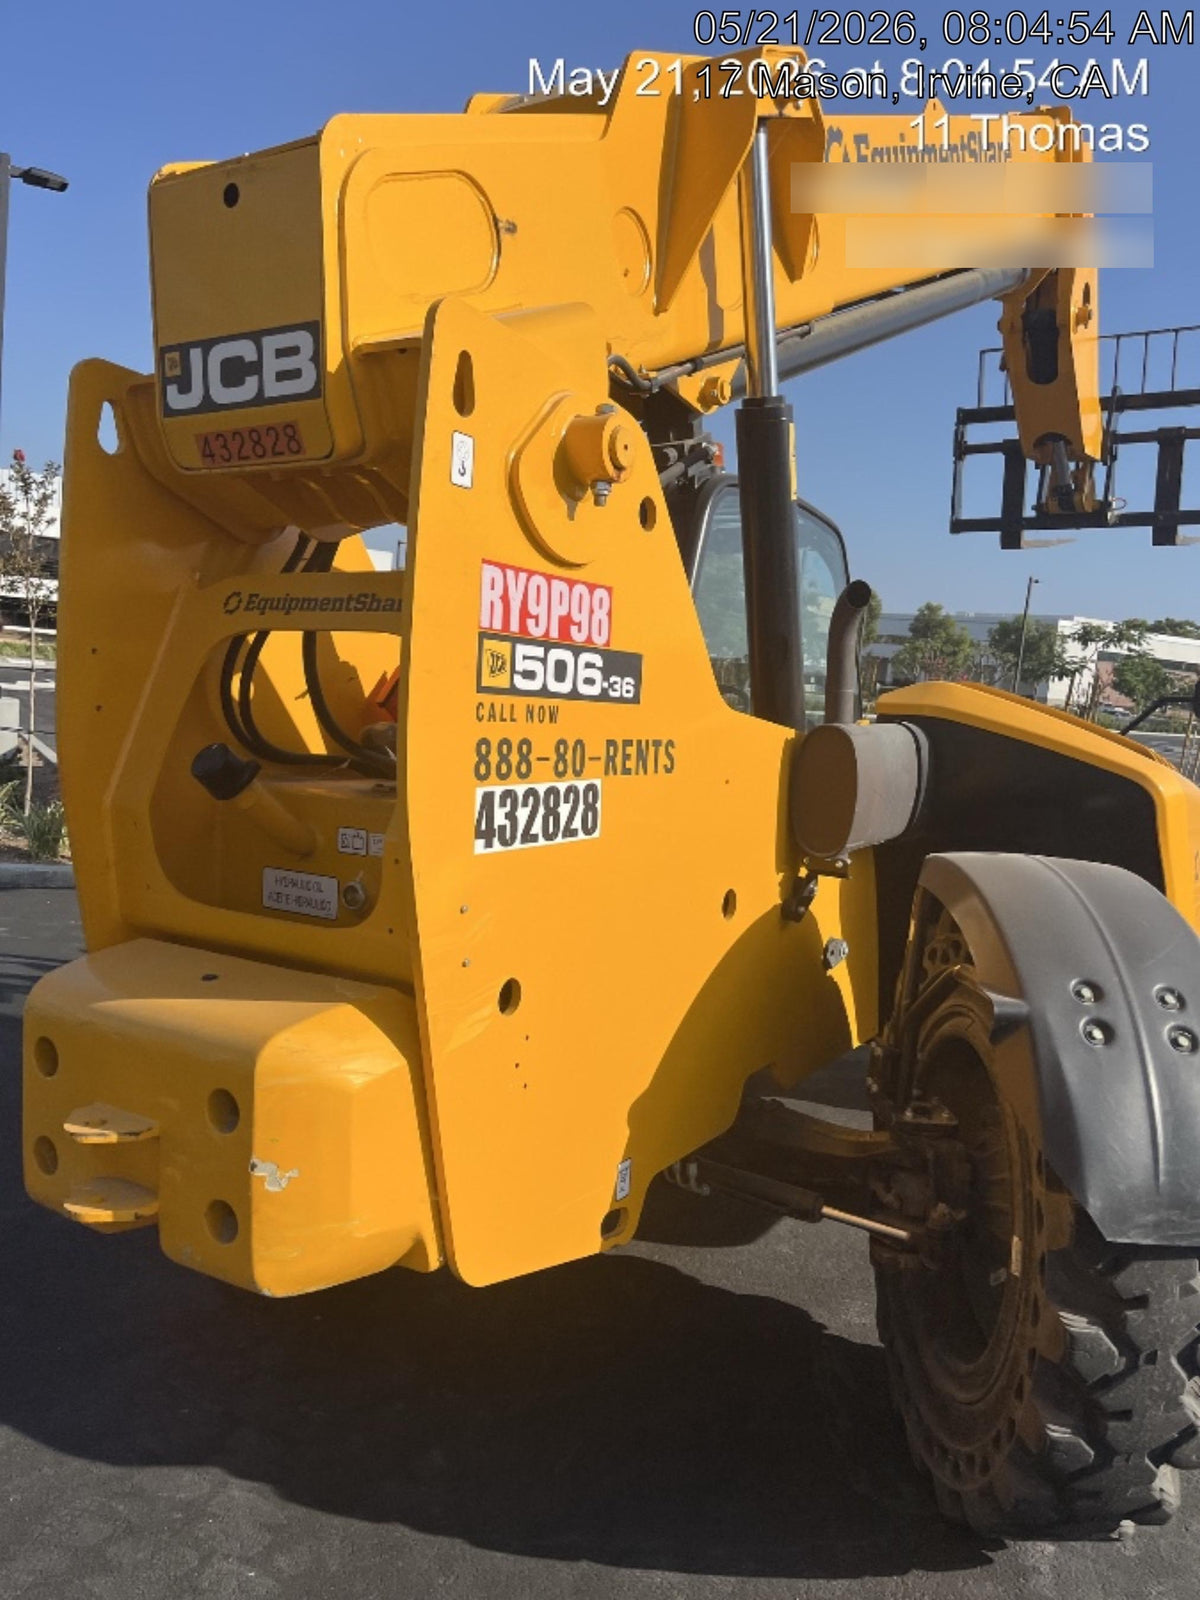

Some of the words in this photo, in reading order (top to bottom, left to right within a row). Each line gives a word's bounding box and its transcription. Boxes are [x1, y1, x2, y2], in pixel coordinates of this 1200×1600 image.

[166, 329, 319, 410] JCB
[202, 424, 303, 464] 432828
[480, 563, 611, 646] RY9P98
[475, 701, 518, 724] CALL
[525, 704, 560, 725] NOW
[474, 736, 677, 783] 888-80-RENTS
[474, 782, 600, 850] 432828
